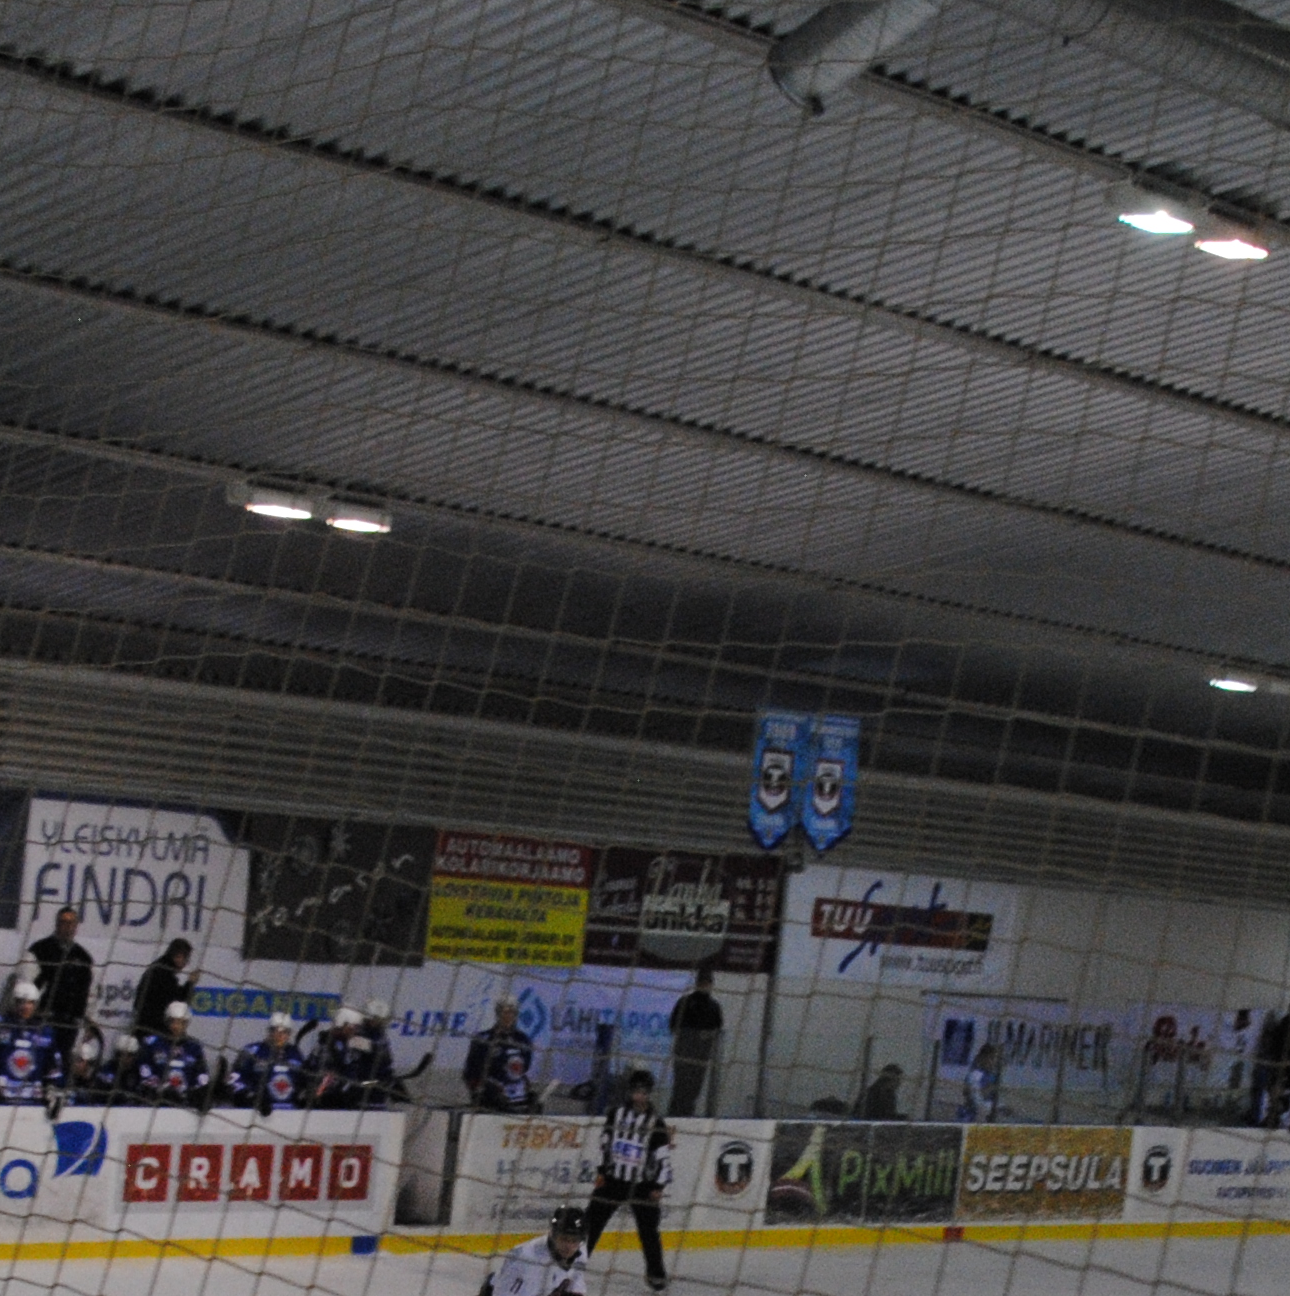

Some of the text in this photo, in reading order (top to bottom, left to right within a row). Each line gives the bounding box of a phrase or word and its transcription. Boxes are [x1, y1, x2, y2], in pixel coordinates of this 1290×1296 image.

[31, 861, 208, 933] FINDRI
[129, 1151, 365, 1196] CRAMO
[838, 1145, 957, 1199] PixMill
[965, 1152, 1125, 1194] SEEPSULA
